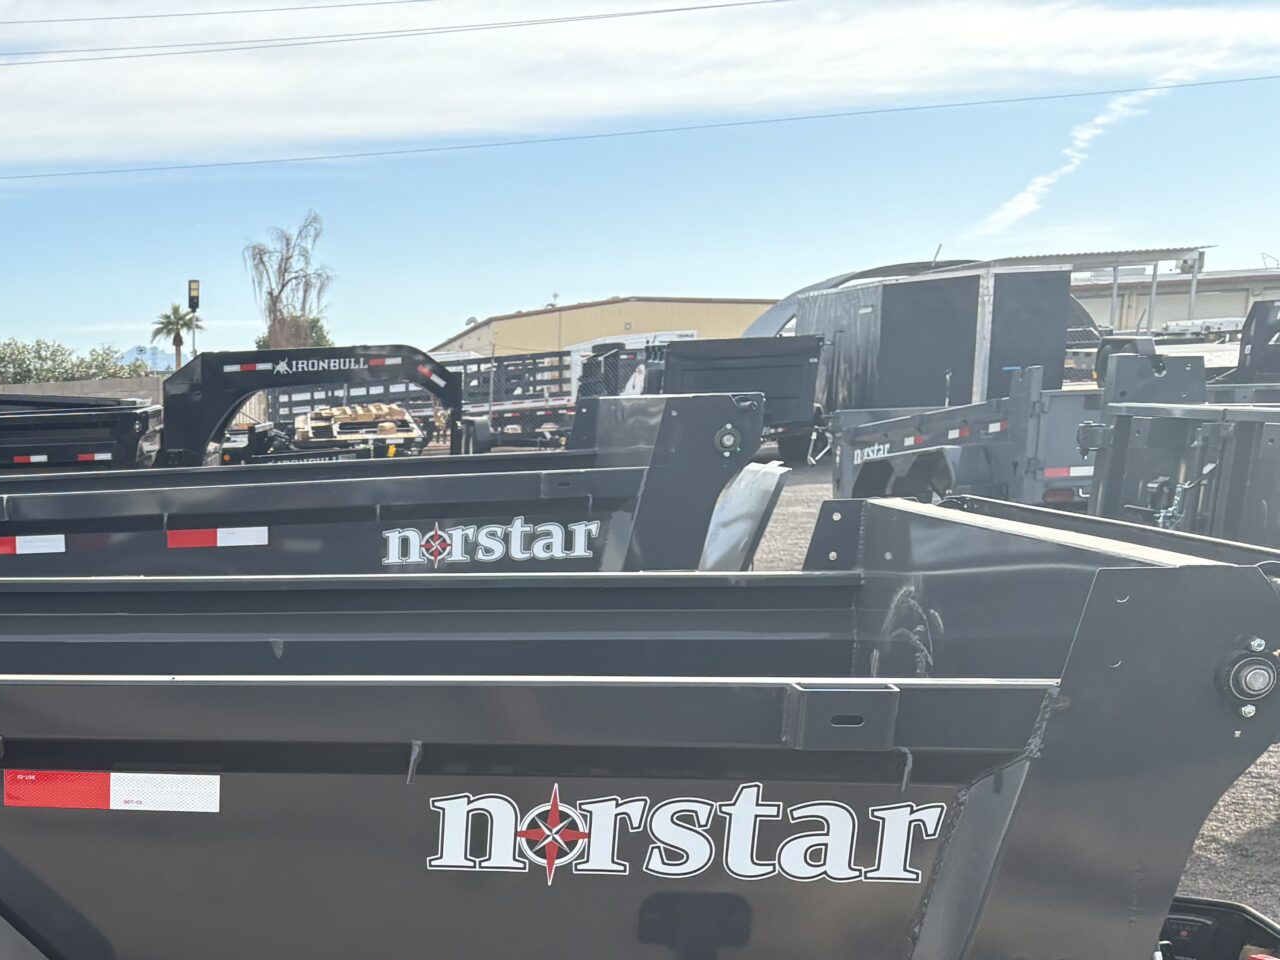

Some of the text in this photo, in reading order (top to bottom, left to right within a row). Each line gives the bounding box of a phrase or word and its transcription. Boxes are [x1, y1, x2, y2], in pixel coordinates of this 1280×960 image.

[292, 358, 368, 372] IRONBULL
[382, 516, 601, 567] norstar
[426, 782, 948, 885] norstar
